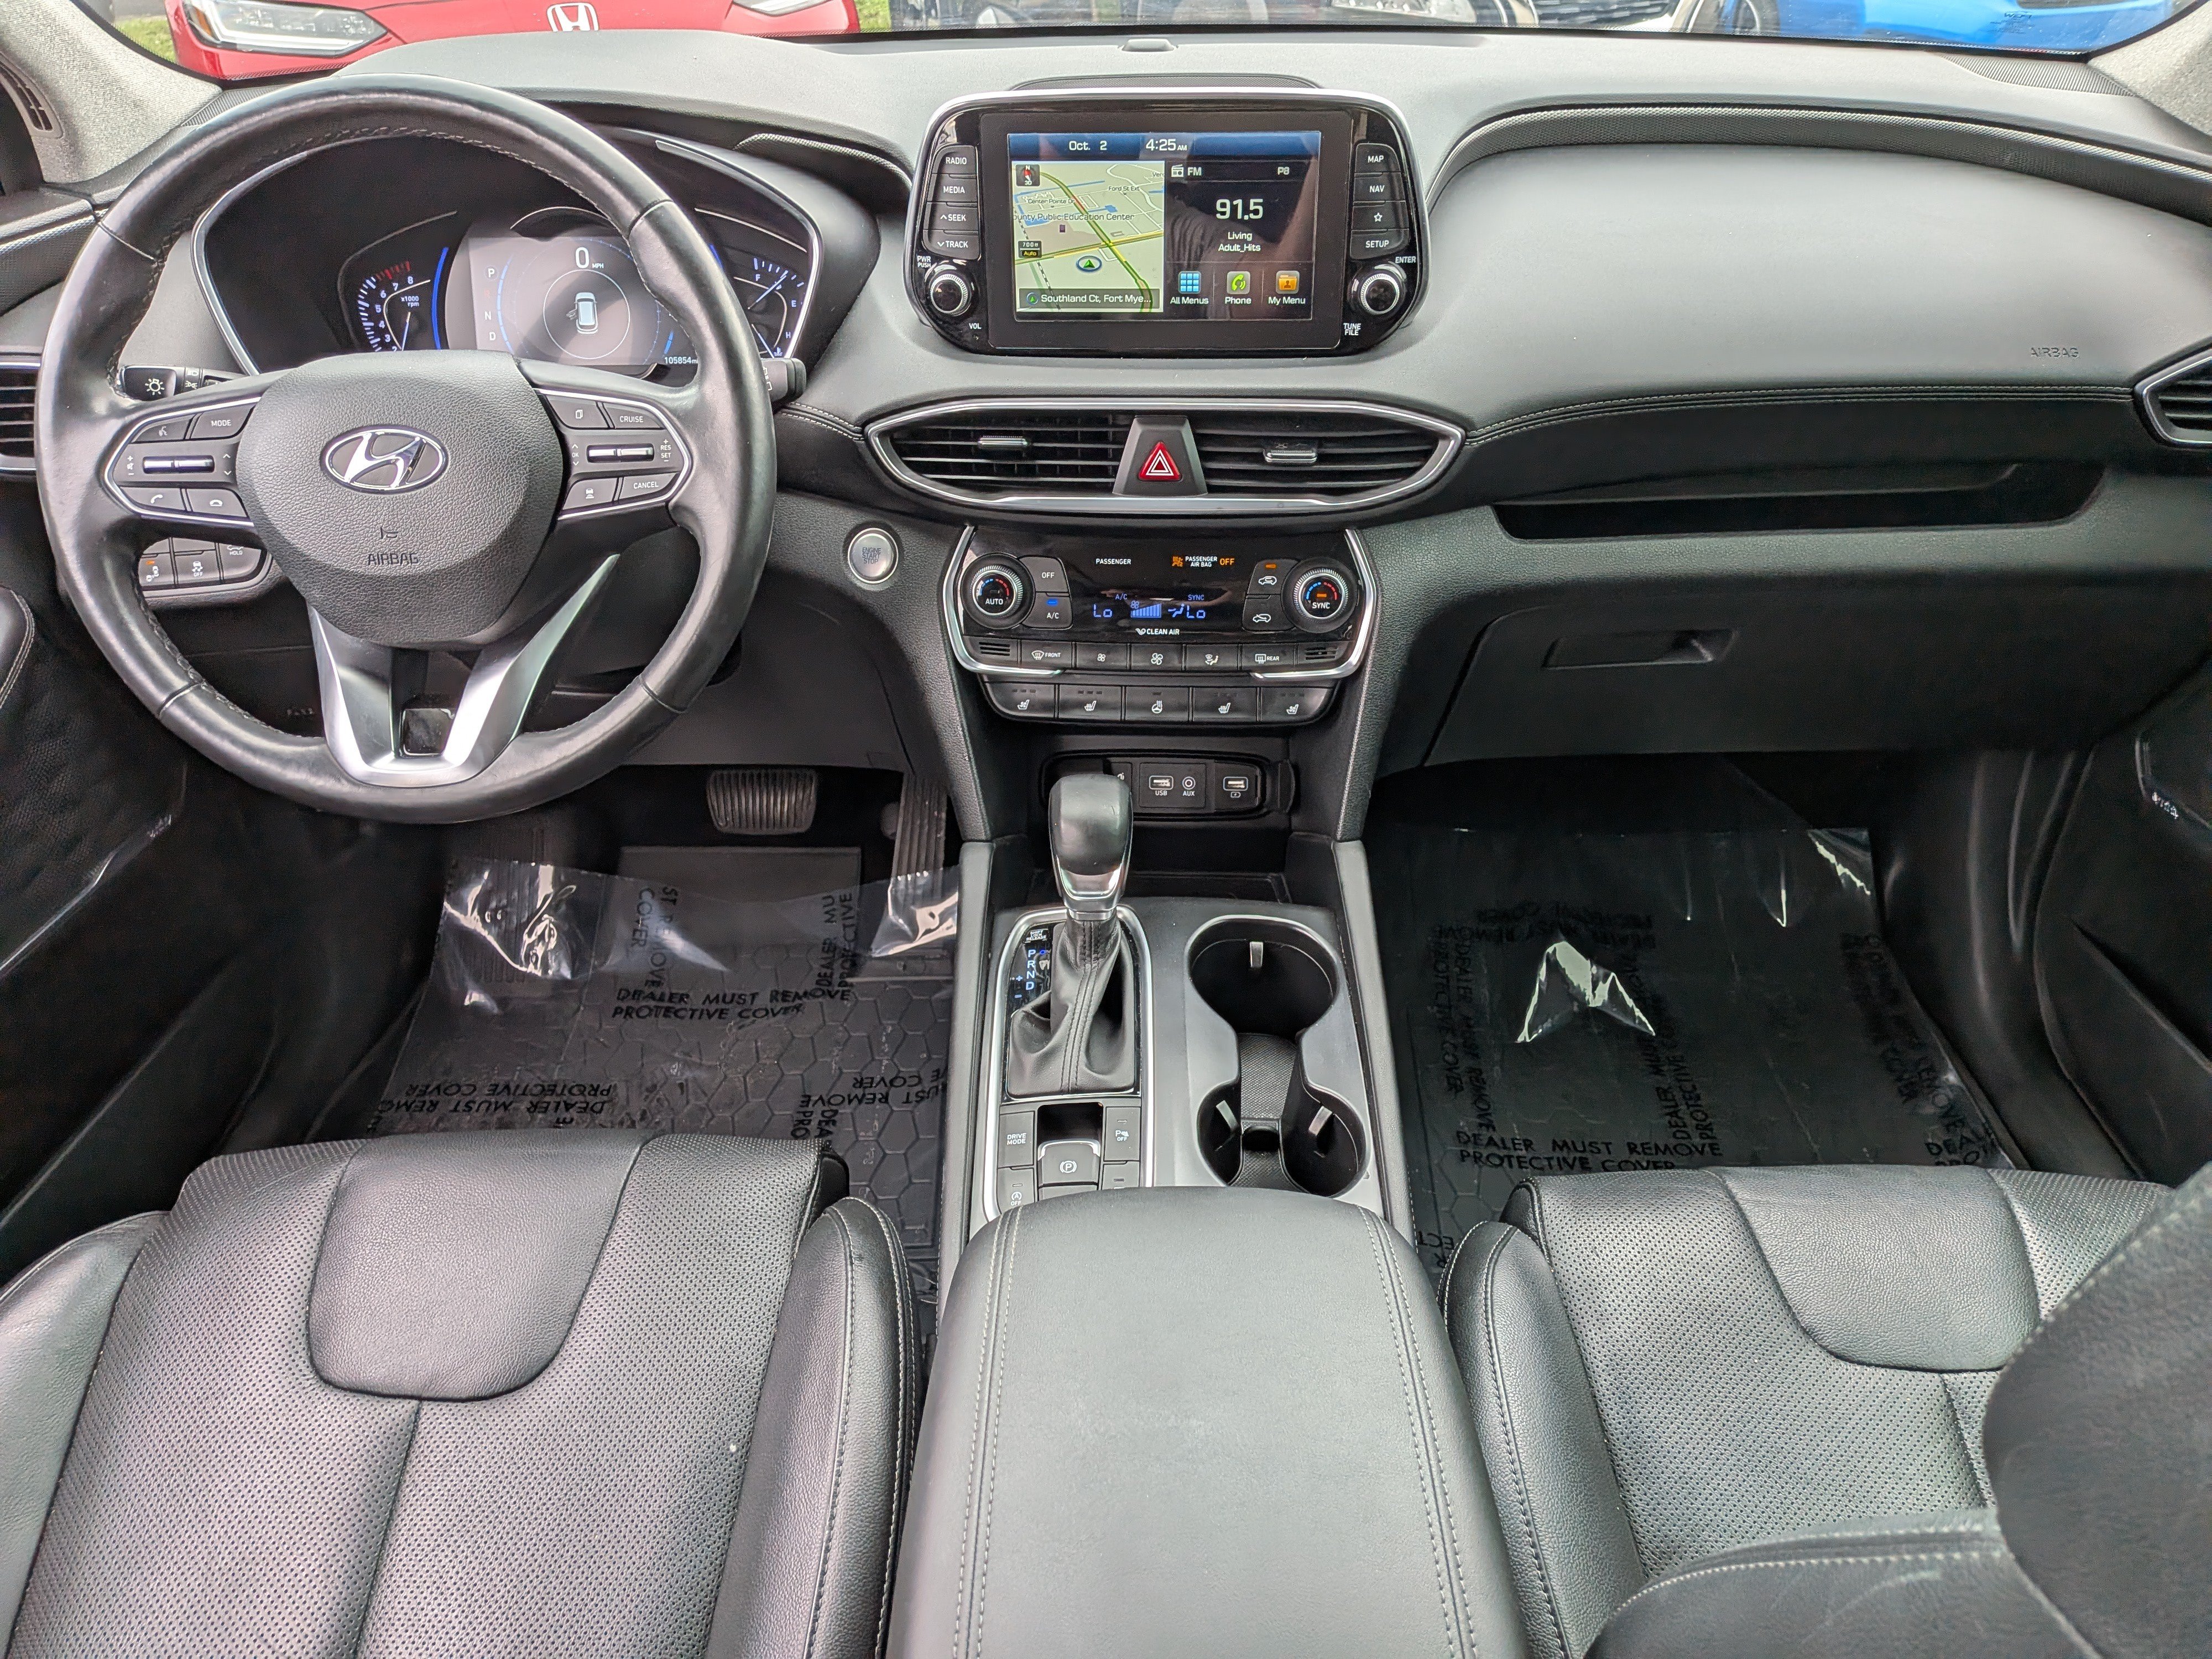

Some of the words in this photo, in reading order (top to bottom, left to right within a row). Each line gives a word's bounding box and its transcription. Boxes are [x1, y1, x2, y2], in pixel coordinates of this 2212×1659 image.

[1068, 140, 1091, 151] Oct.
[1099, 140, 1107, 150] 2
[1145, 139, 1177, 151] 4:25
[1188, 167, 1202, 176] FM
[1277, 166, 1290, 175] P8
[1216, 199, 1264, 220] 91.5
[1228, 232, 1253, 241] Living
[1218, 243, 1261, 252] Adult_Hits
[1365, 240, 1389, 248] SETUP
[575, 247, 589, 269] 0
[488, 268, 495, 278] P
[407, 276, 414, 284] 8
[392, 283, 399, 291] 7
[380, 290, 387, 298] 6
[1041, 294, 1087, 302] Southland
[1089, 294, 1101, 304] Ct,
[1104, 294, 1123, 302] Fort
[1125, 294, 1151, 304] Mye...
[1268, 296, 1280, 306] My
[375, 304, 382, 312] 5
[485, 311, 492, 320] N
[379, 320, 385, 328] 4
[385, 334, 391, 342] 3
[489, 332, 496, 341] D
[2031, 347, 2079, 358] AIRBAG
[211, 419, 232, 427] MODE
[633, 481, 659, 489] CANCEL
[368, 552, 419, 566] AIRBAG
[661, 886, 679, 906] ST
[822, 895, 837, 924] MU
[1028, 950, 1036, 958] P
[1027, 960, 1035, 968] R
[1026, 970, 1035, 979] N
[1025, 981, 1035, 990] D
[702, 990, 760, 1006] MUST
[770, 987, 852, 1003] REMOVE
[612, 1005, 728, 1020] PROTECTIVE
[852, 1075, 923, 1089] COVER
[405, 1083, 477, 1097] COVER
[487, 1083, 613, 1097] PROTECTIVE
[902, 1084, 939, 1105] UST
[799, 1092, 890, 1108] REMOVE
[450, 1100, 515, 1113] MUST
[526, 1100, 607, 1114] DEALER
[814, 1109, 839, 1139] DEA
[1457, 1130, 1535, 1152] DEALER
[1552, 1139, 1613, 1155] MUST
[1627, 1141, 1723, 1157] REMOVE
[1459, 1149, 1591, 1171] PROTECTIVE
